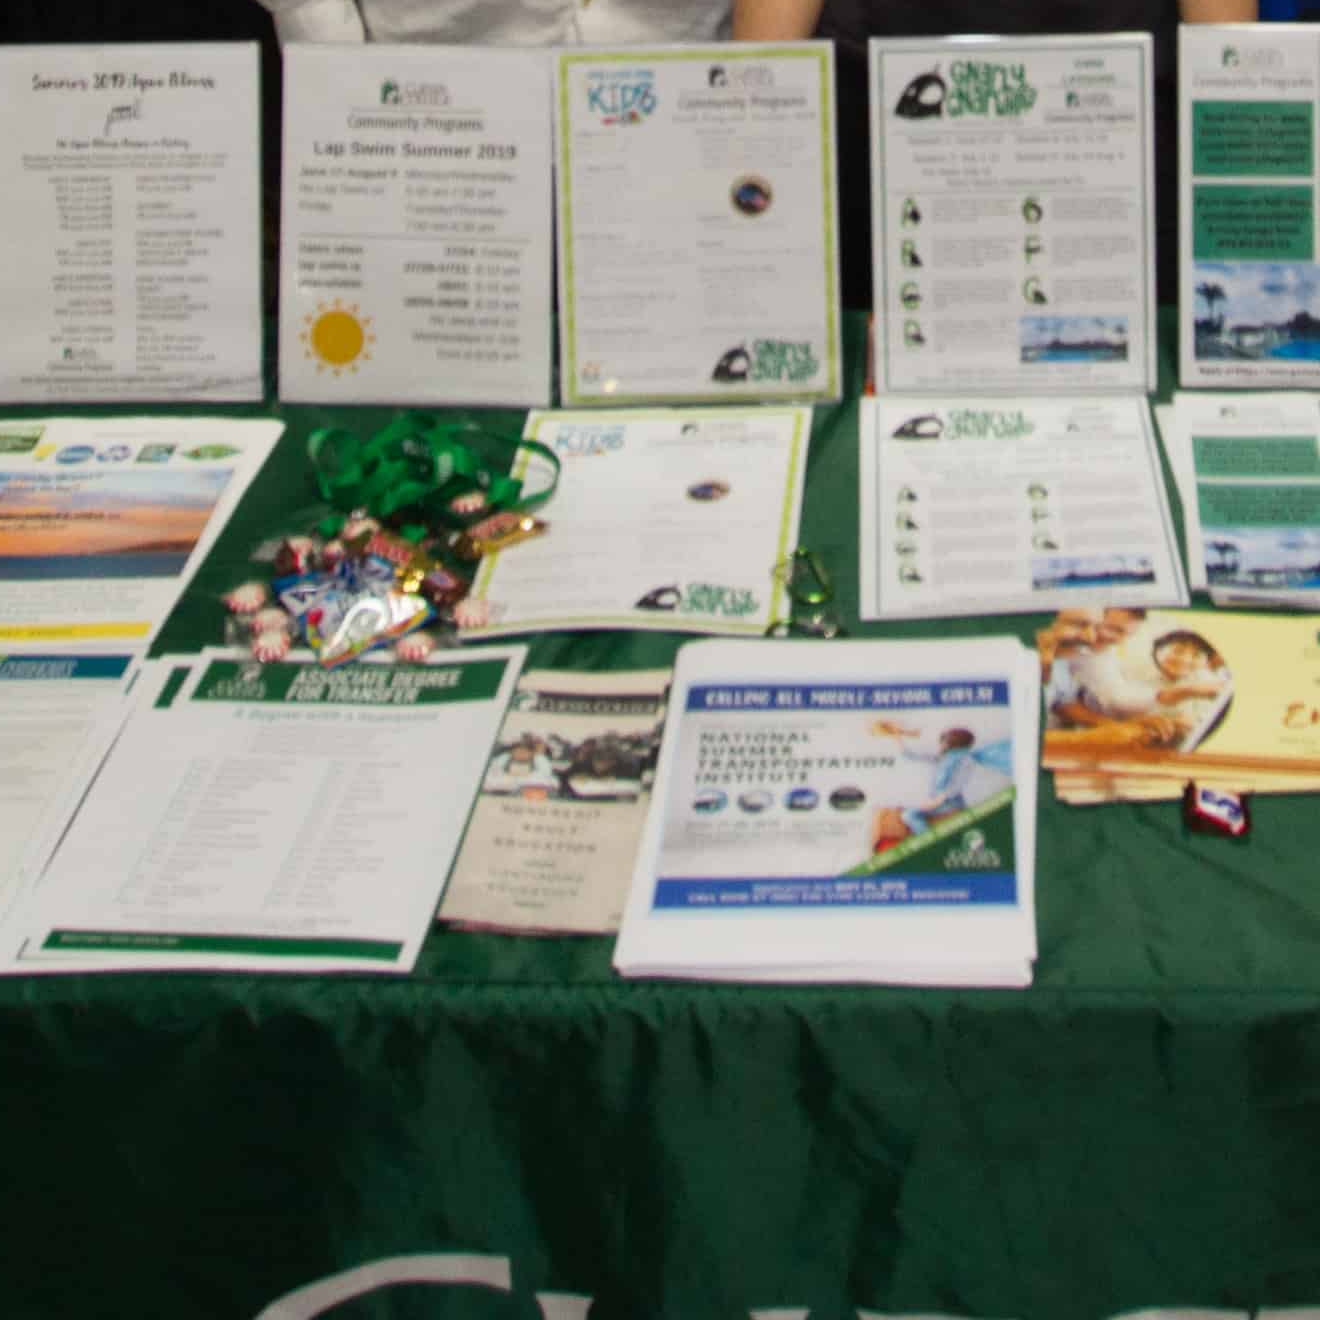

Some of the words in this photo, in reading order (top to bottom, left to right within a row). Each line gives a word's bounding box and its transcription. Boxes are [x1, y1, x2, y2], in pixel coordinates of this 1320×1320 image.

[313, 141, 346, 158] Lap
[350, 141, 395, 157] Swim
[401, 142, 471, 159] Summer
[293, 668, 391, 687] ASSOCIATE
[391, 668, 463, 687] DEGREE
[285, 686, 327, 703] FOR
[328, 686, 421, 705] TRANSFER
[699, 731, 811, 745] NATIONAL
[697, 744, 794, 757] SUMMER
[696, 756, 897, 770] TRANSPORTATION
[694, 770, 810, 785] INSTITUTE
